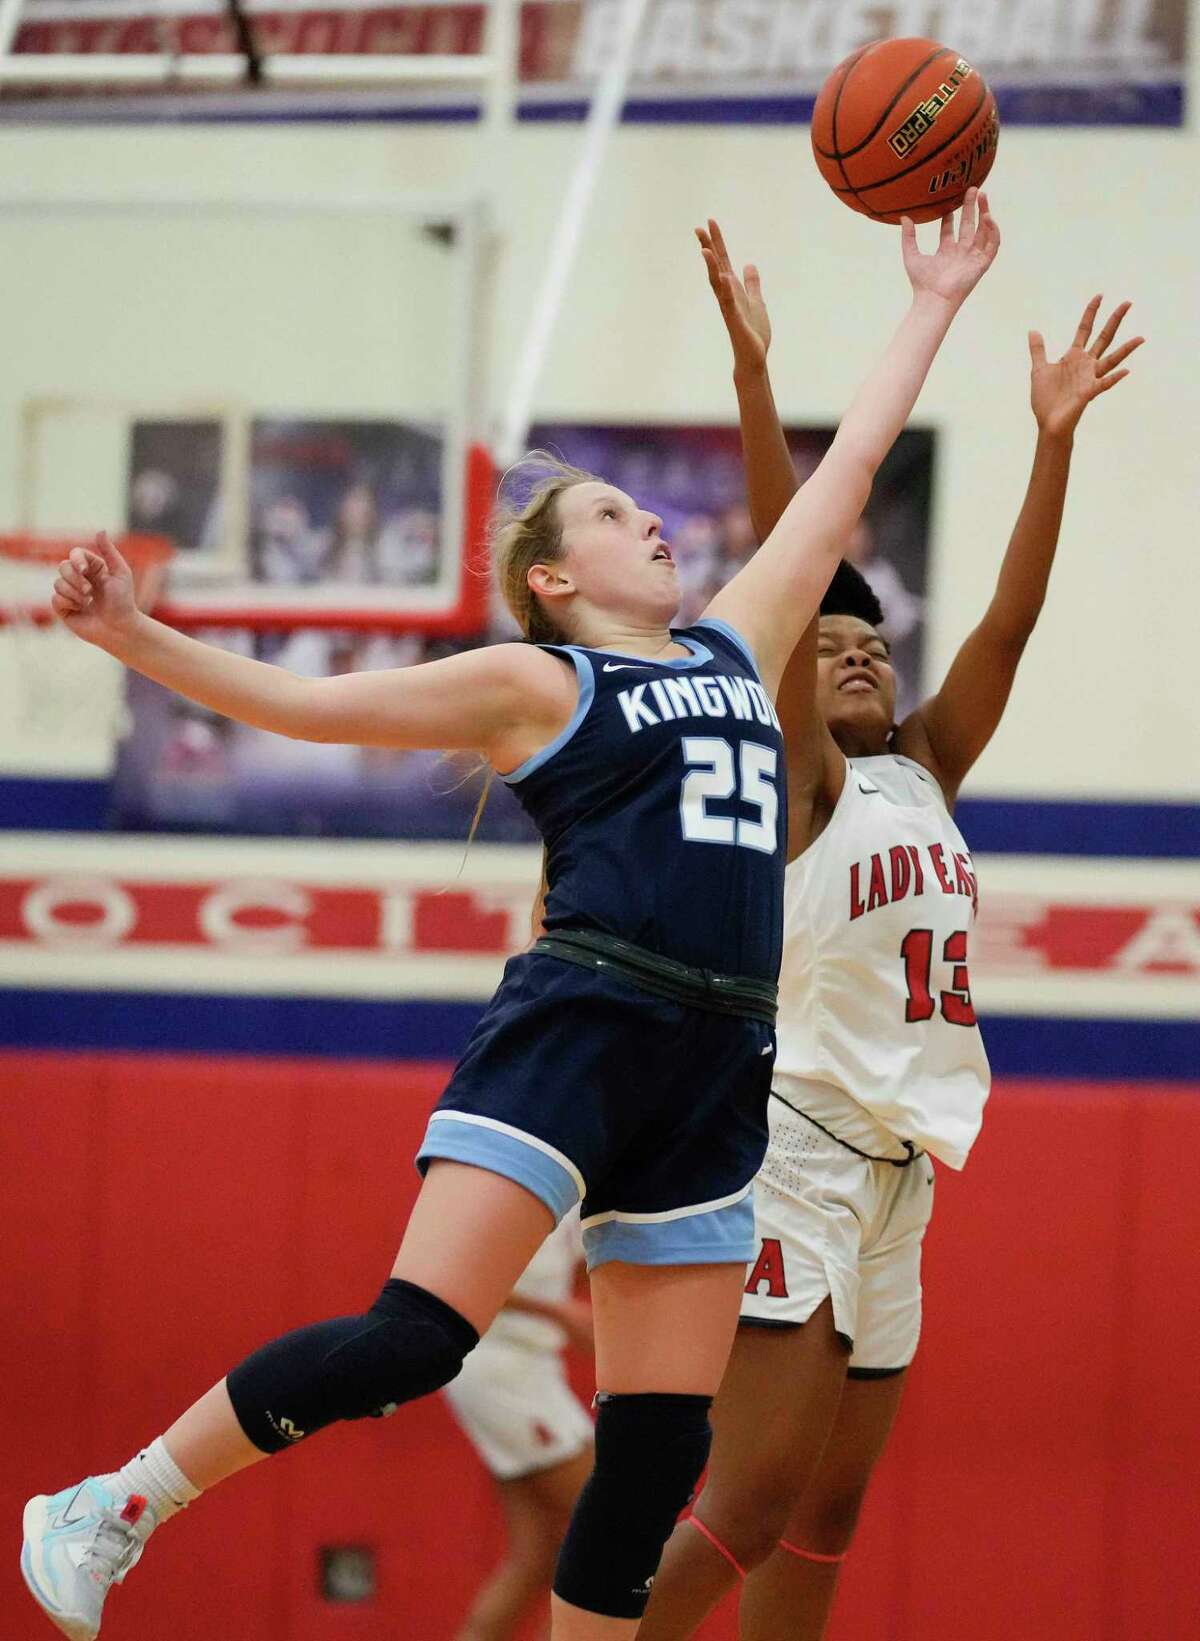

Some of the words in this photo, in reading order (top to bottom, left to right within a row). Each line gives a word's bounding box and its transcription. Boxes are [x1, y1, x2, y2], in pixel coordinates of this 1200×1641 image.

[889, 108, 934, 158] PRO
[680, 736, 778, 856] 25
[849, 844, 924, 921] LADY
[900, 928, 976, 1027] 13
[744, 1237, 789, 1298] A
